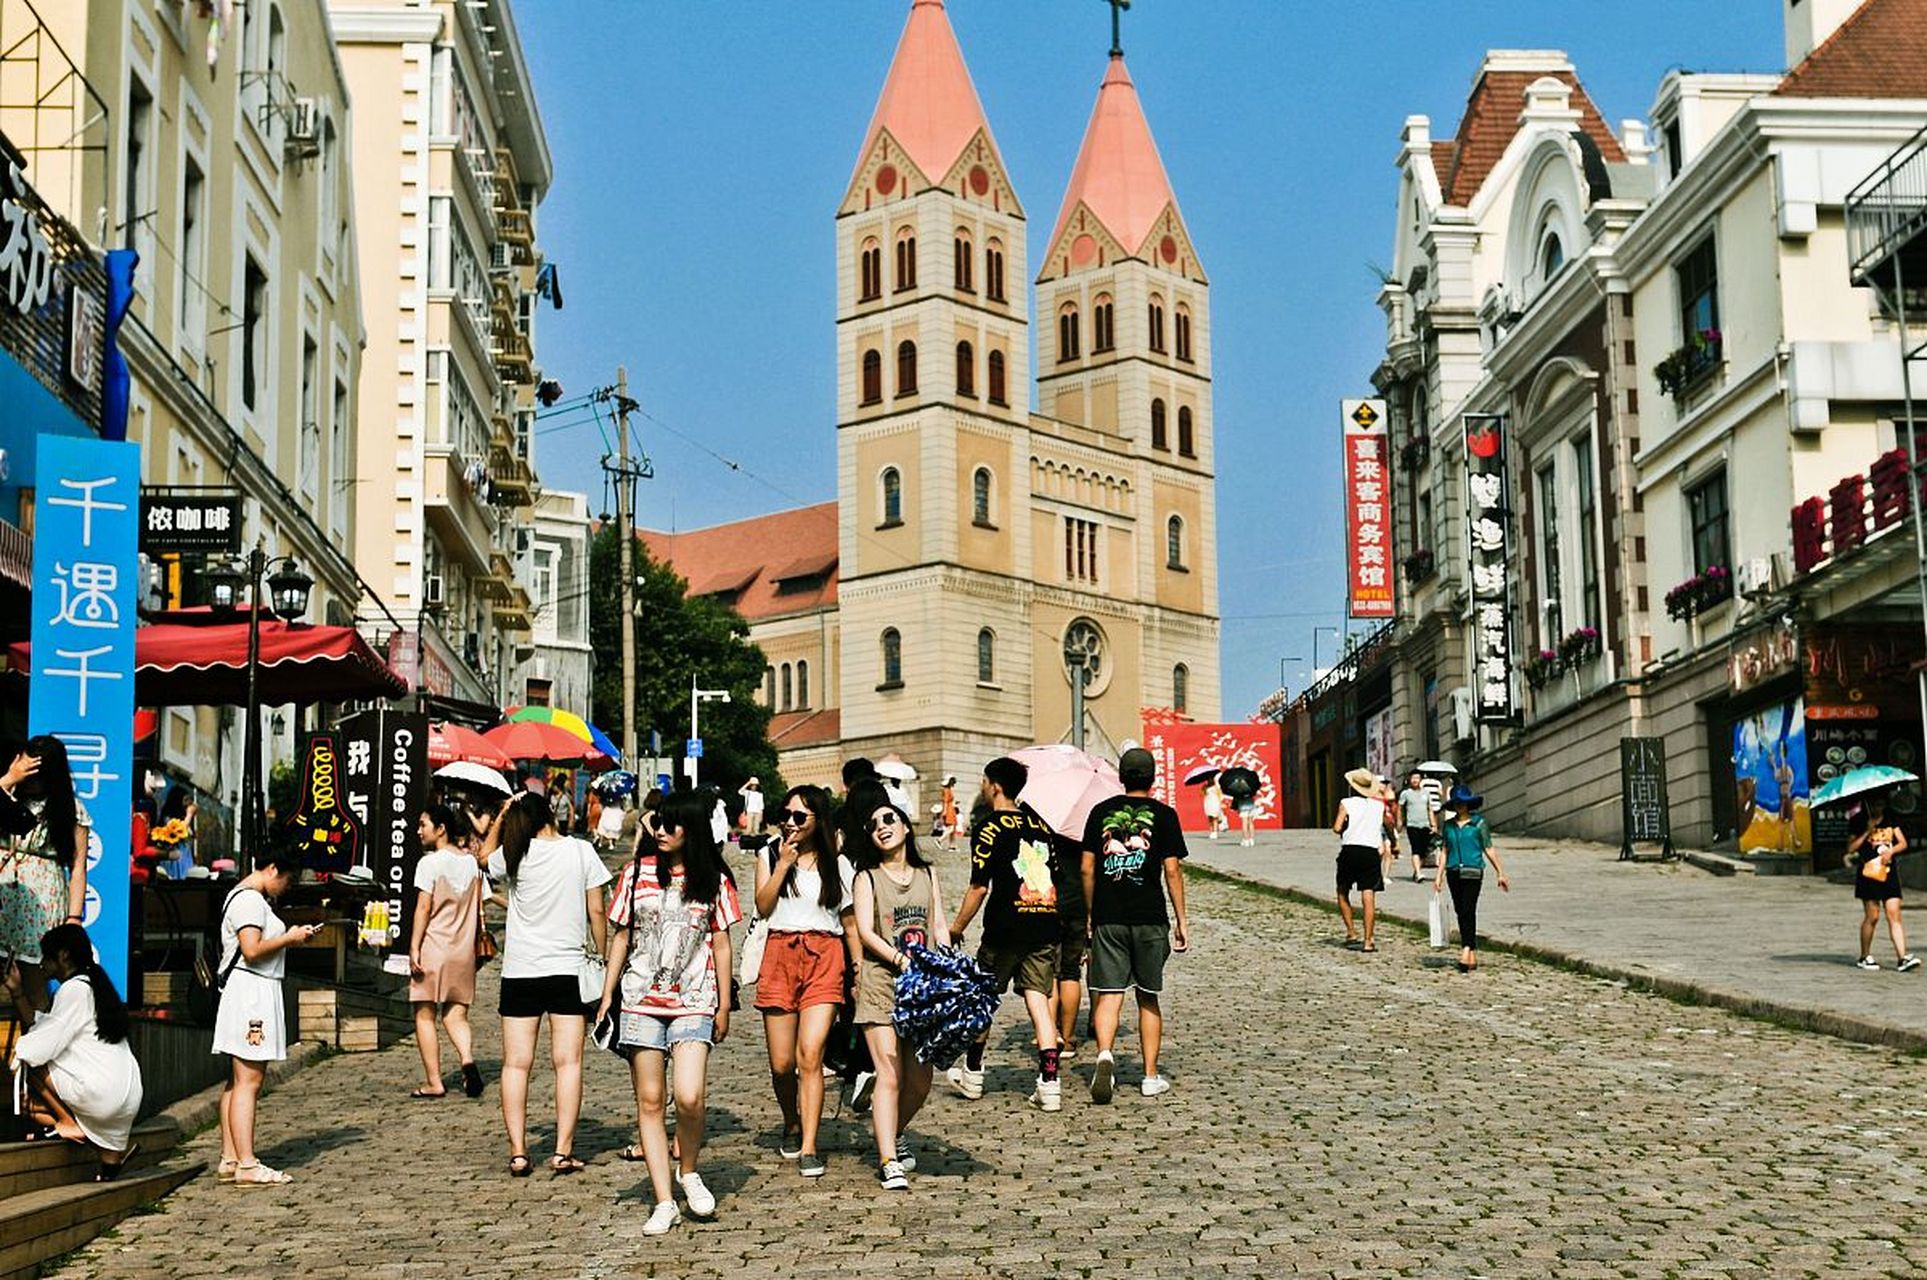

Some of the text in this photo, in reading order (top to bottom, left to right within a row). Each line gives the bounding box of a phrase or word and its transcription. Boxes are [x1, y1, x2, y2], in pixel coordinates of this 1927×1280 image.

[147, 505, 230, 531] 侬咖啡
[1354, 438, 1385, 586] 喜来客商务宾馆
[43, 476, 127, 799] 千遇千寻
[1356, 591, 1390, 599] HOTEL
[388, 729, 413, 939] Coffee tea or me
[972, 821, 1001, 869] SCUM
[1000, 815, 1023, 829] OF
